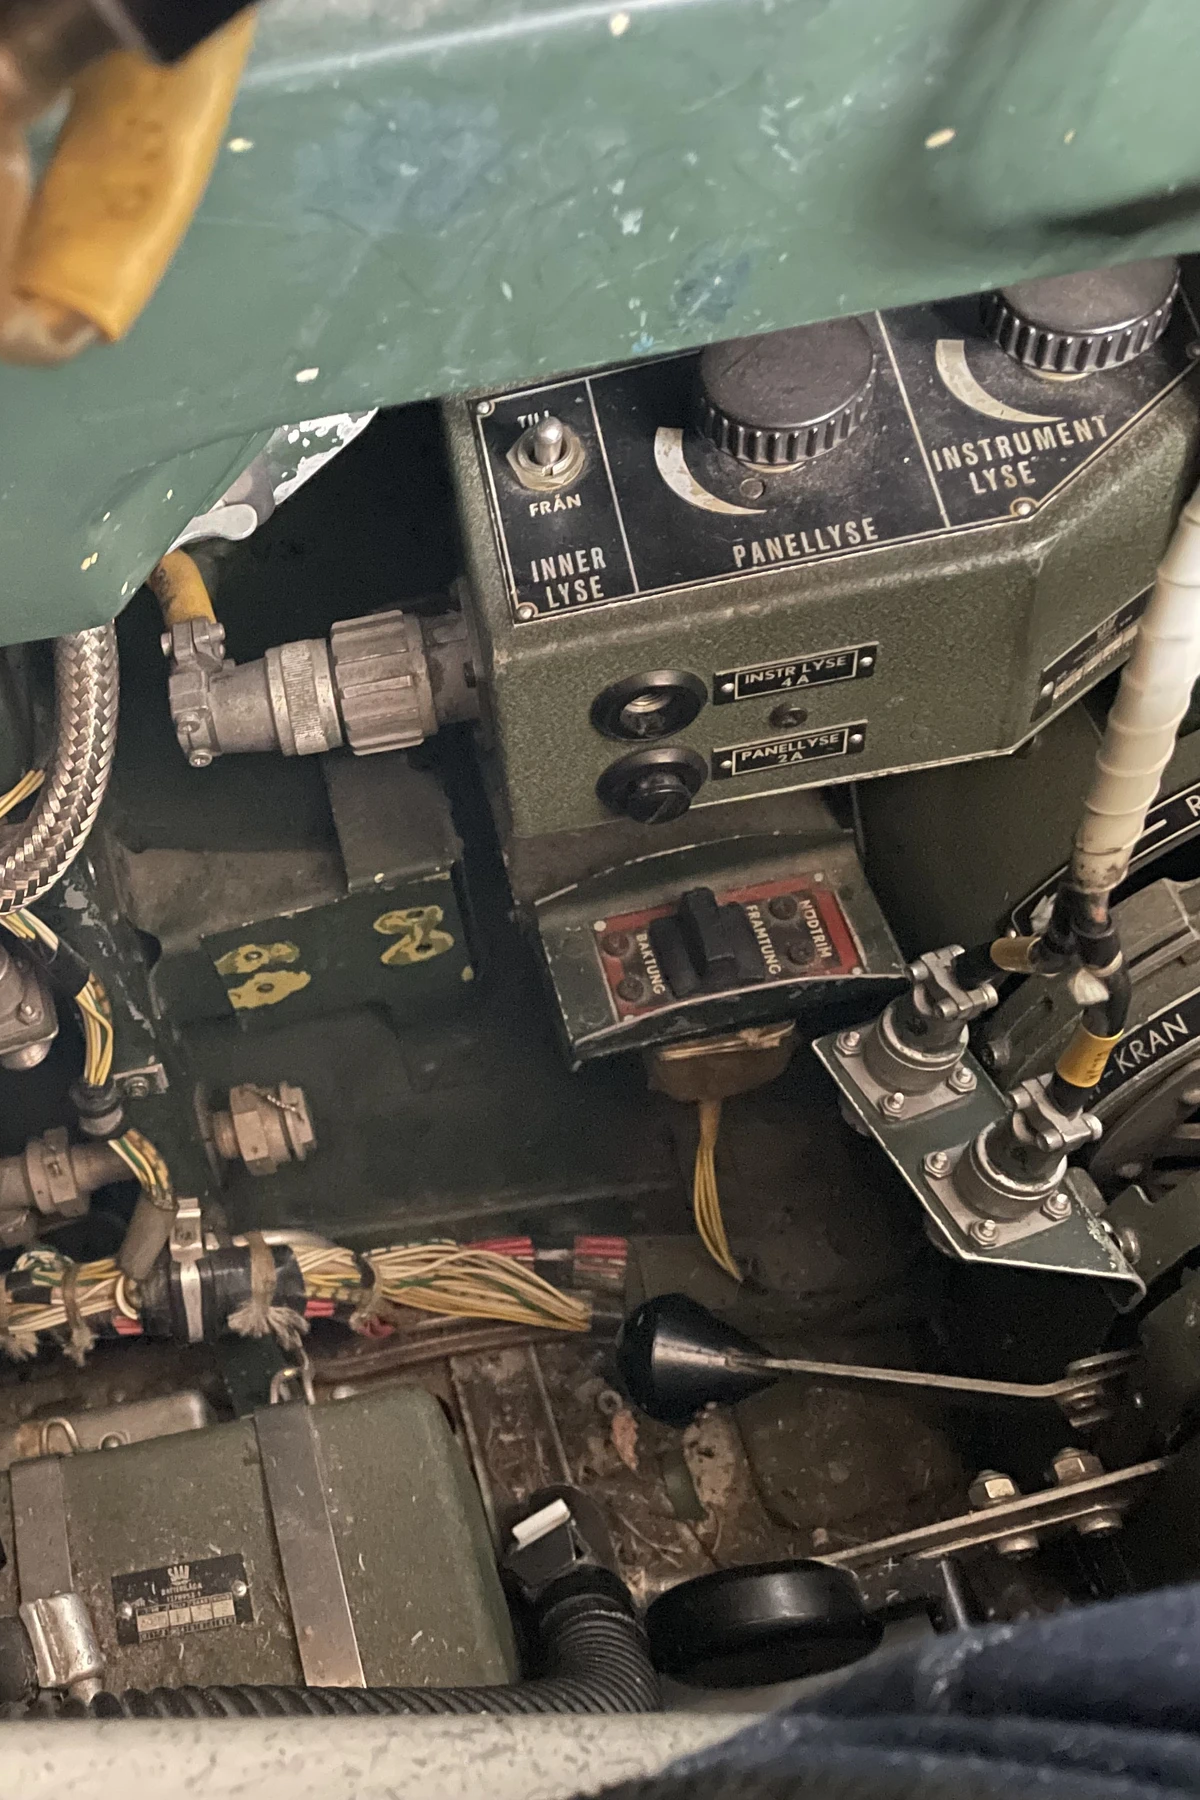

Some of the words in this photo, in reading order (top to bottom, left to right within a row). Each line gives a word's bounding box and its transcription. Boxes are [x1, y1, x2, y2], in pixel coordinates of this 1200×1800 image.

[931, 413, 1108, 473] INSTRUMENT
[968, 460, 1037, 495] LYSE
[528, 493, 582, 518] FRÅN
[732, 517, 879, 569] PANELLYSE
[530, 546, 607, 584] INNER
[545, 575, 605, 609] LYSE
[744, 665, 796, 685] INSTR
[801, 655, 848, 674] LYSE
[781, 678, 792, 688] 4
[796, 674, 810, 685] A
[741, 733, 840, 762] PANELLYSE
[777, 754, 788, 764] 2
[790, 751, 804, 762] A
[745, 904, 782, 976] FRAMTUNG
[635, 933, 667, 996] BAKTUNG
